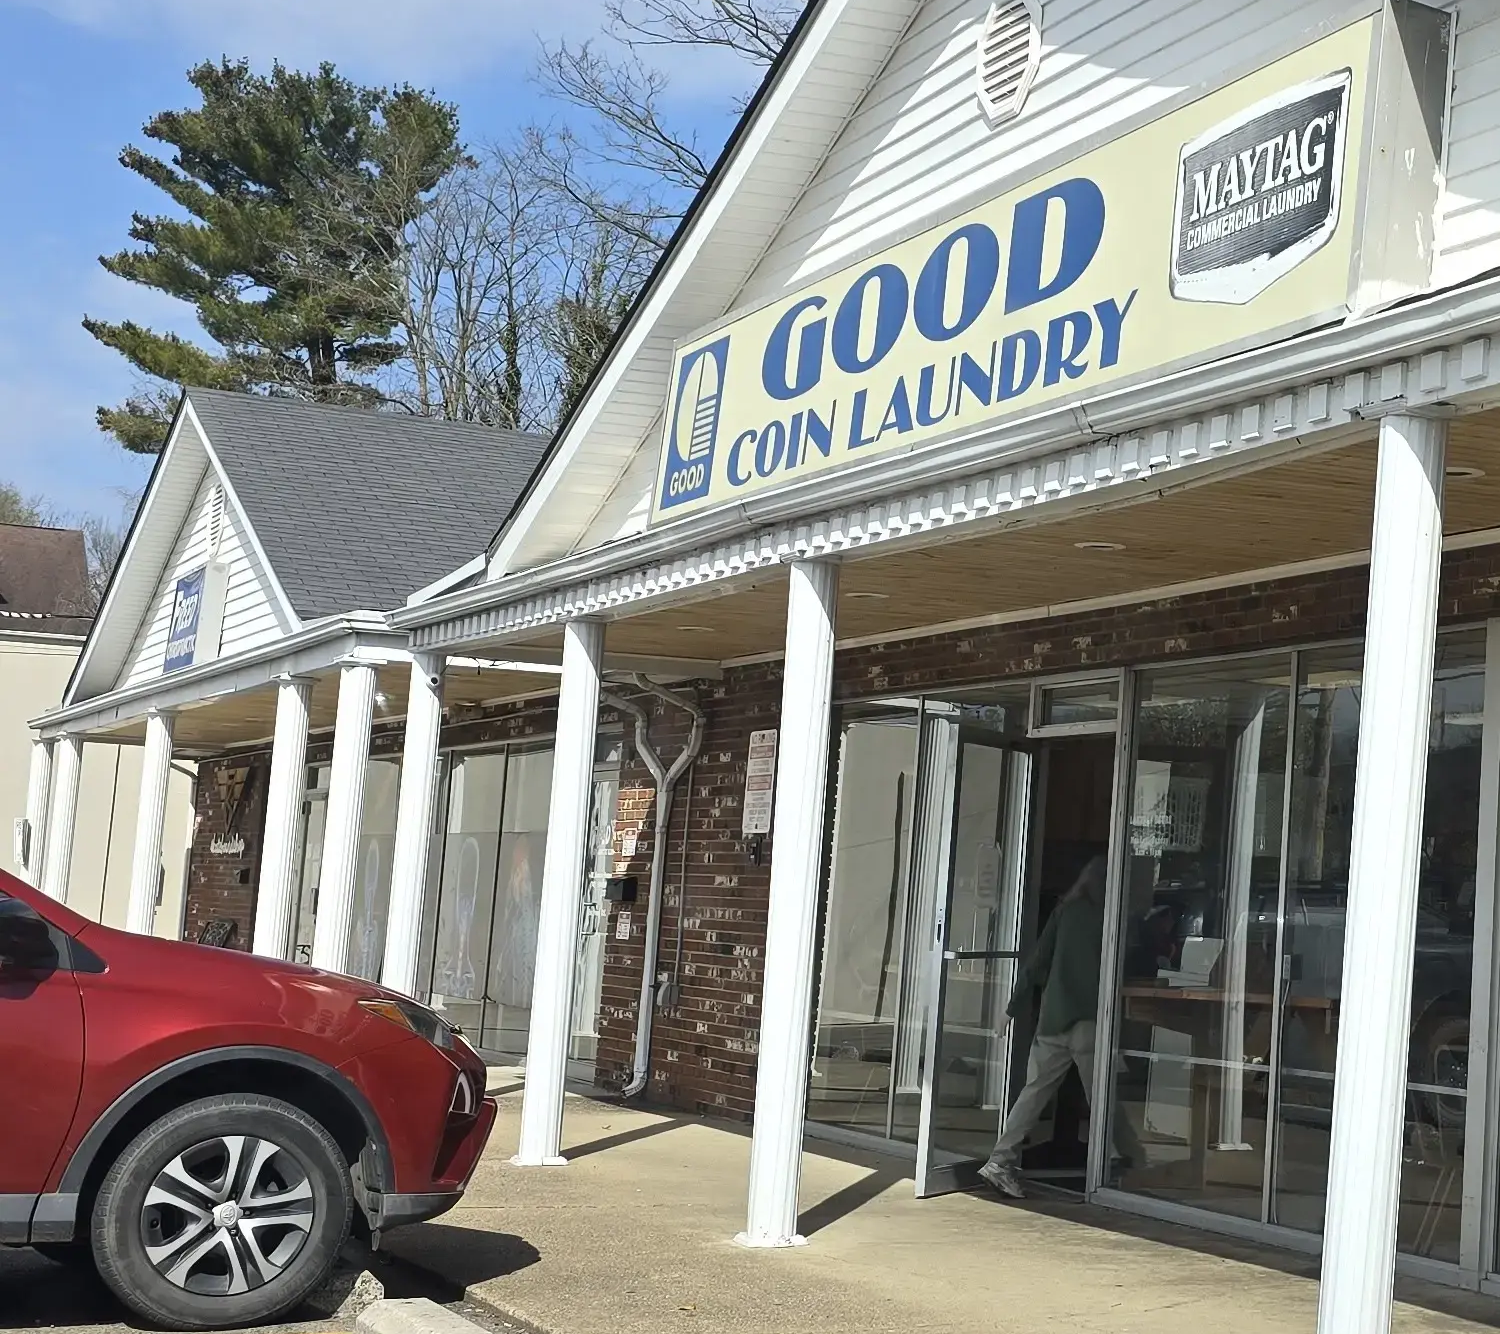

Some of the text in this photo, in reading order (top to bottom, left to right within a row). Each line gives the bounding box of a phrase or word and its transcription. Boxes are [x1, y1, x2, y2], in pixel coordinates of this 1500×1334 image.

[1186, 176, 1322, 251] COMMERCIAL LAUNDRY
[761, 177, 1106, 401] GOOD
[726, 288, 1139, 487] COIN LAUNDRY
[669, 463, 705, 497] GOOD
